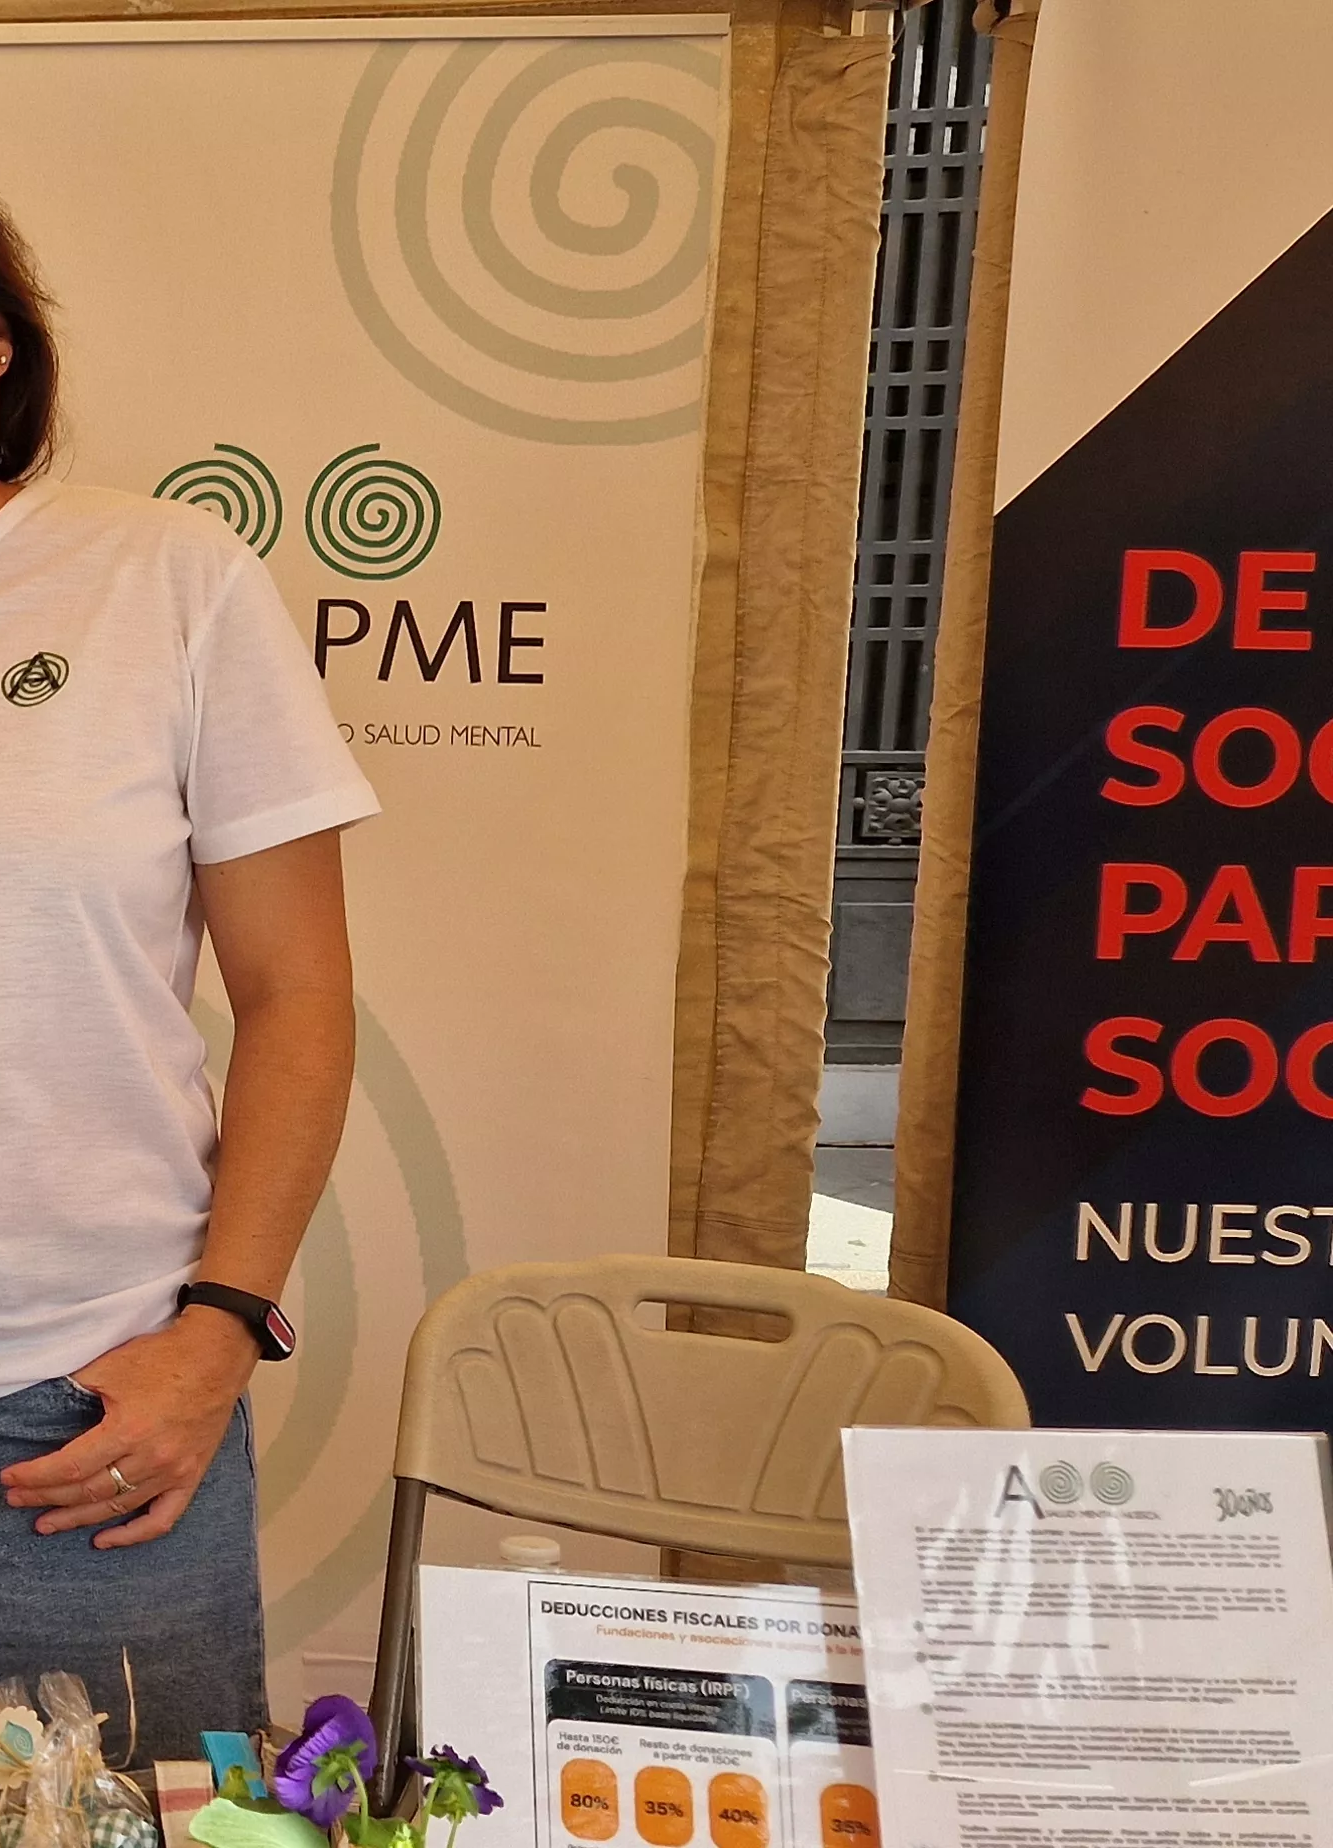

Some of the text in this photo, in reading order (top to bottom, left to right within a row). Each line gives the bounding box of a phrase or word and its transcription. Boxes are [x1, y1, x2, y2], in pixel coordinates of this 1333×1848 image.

[1118, 549, 1316, 651] DE
[314, 598, 547, 684] PME
[364, 723, 440, 746] SALUD
[450, 725, 542, 749] MENTAL
[1100, 705, 1333, 809] SO
[541, 1600, 862, 1639] DEDUCCIONES FISCALES POR DONA
[595, 1624, 675, 1642] Fundaciones
[679, 1633, 687, 1645] y
[566, 1670, 751, 1699] Personas físicas (IRPF)
[791, 1688, 868, 1709] Personas
[559, 1731, 619, 1744] Hasta 150€
[557, 1742, 622, 1755] de donación
[639, 1738, 753, 1758] Resto de donaciones
[662, 1752, 694, 1764] partir
[697, 1754, 710, 1763] de
[712, 1755, 741, 1766] 150€
[570, 1793, 610, 1811] 80%
[644, 1800, 684, 1819] 35%
[718, 1806, 758, 1825] 40%
[830, 1819, 871, 1836] 35%
